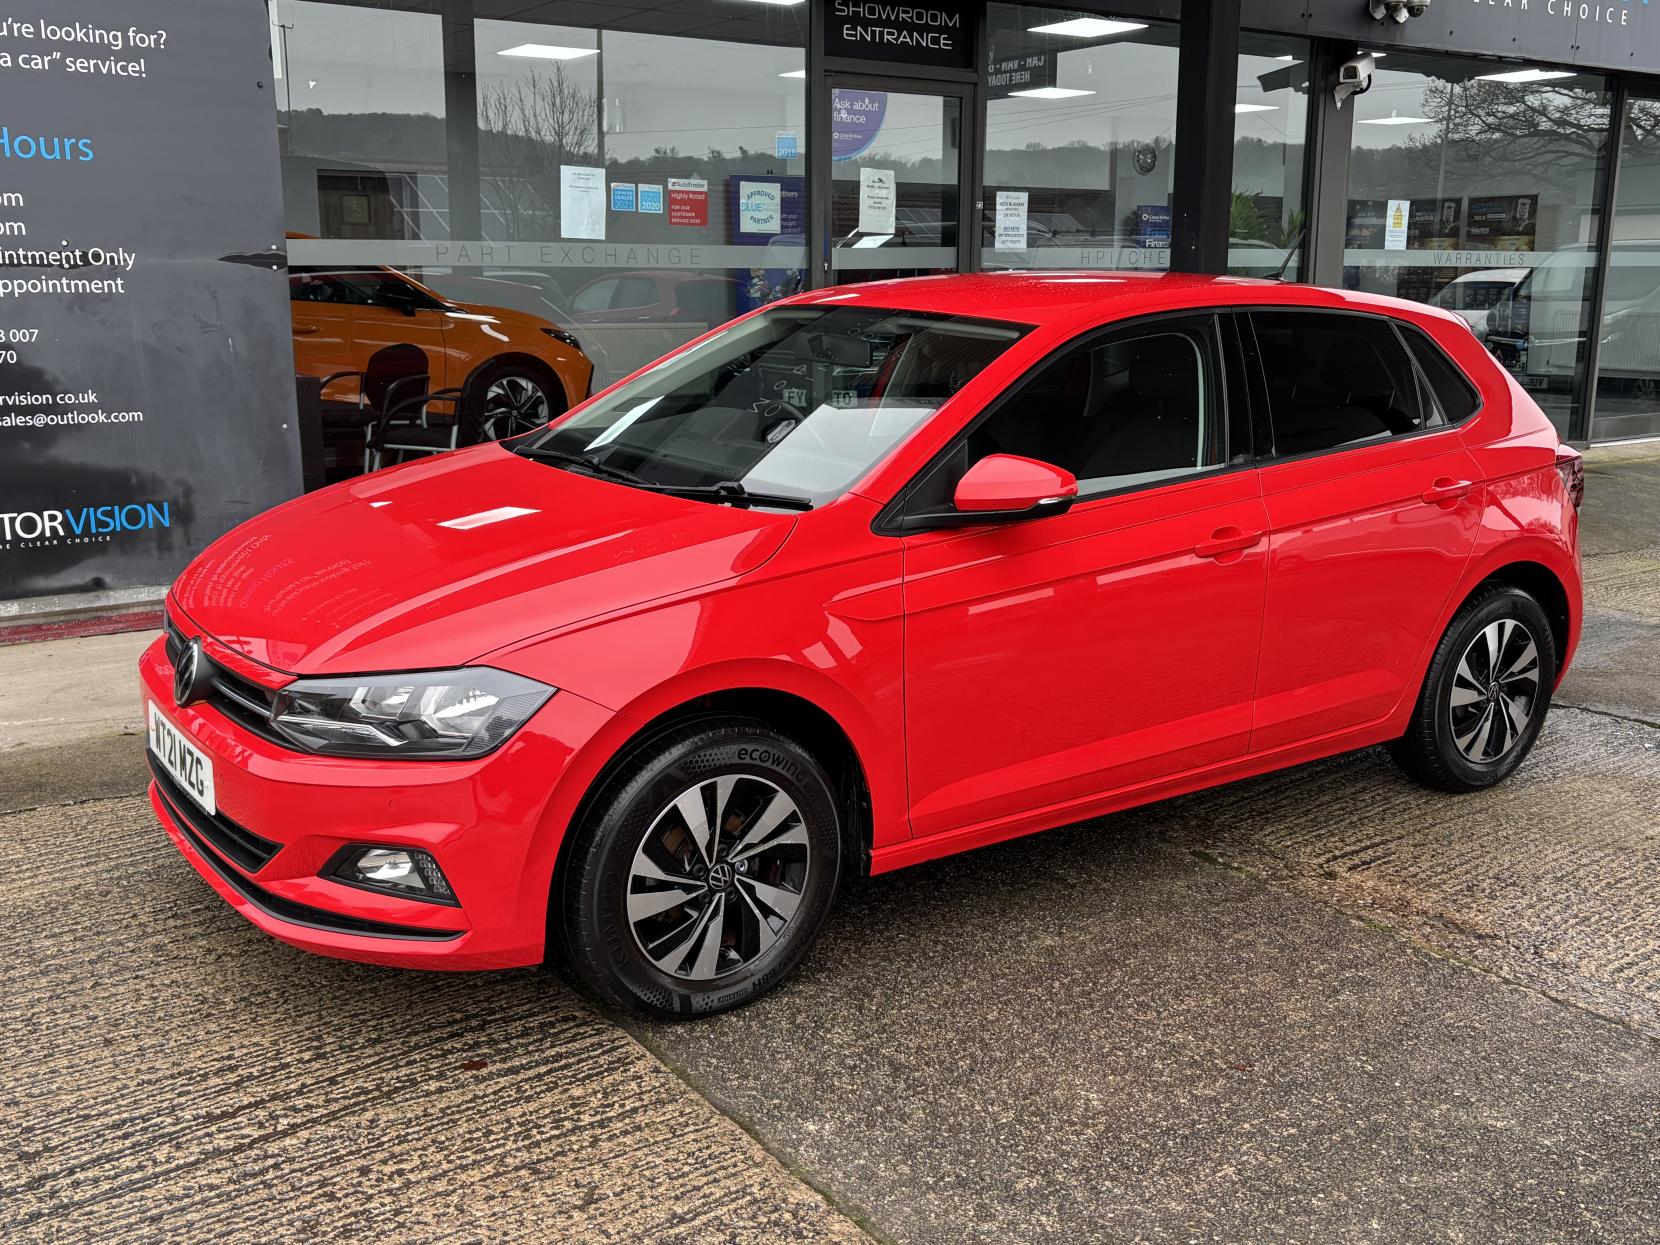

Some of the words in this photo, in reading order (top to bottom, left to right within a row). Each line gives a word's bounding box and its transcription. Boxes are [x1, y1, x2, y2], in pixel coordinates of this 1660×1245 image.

[834, 0, 960, 28] SHOWROOM
[1547, 1, 1628, 25] CHOICE
[40, 18, 123, 50] looking
[128, 27, 167, 49] for?
[843, 24, 953, 50] ENTRANCE
[0, 52, 12, 67] a
[65, 56, 147, 78] service!
[833, 98, 851, 109] Ask
[853, 98, 879, 112] about
[833, 111, 867, 124] finance
[746, 190, 775, 201] APPROVED
[641, 201, 660, 210] 2020
[741, 201, 762, 212] BLUE
[749, 214, 775, 225] PARTNER
[88, 248, 136, 271] Only
[436, 244, 515, 263] PART
[541, 246, 701, 265] EXCHANGE
[1433, 252, 1526, 266] WARRANTIES
[9, 329, 39, 343] 007
[20, 539, 58, 548] CLEAR
[67, 535, 111, 545] CHOICE
[178, 739, 205, 798] MZG
